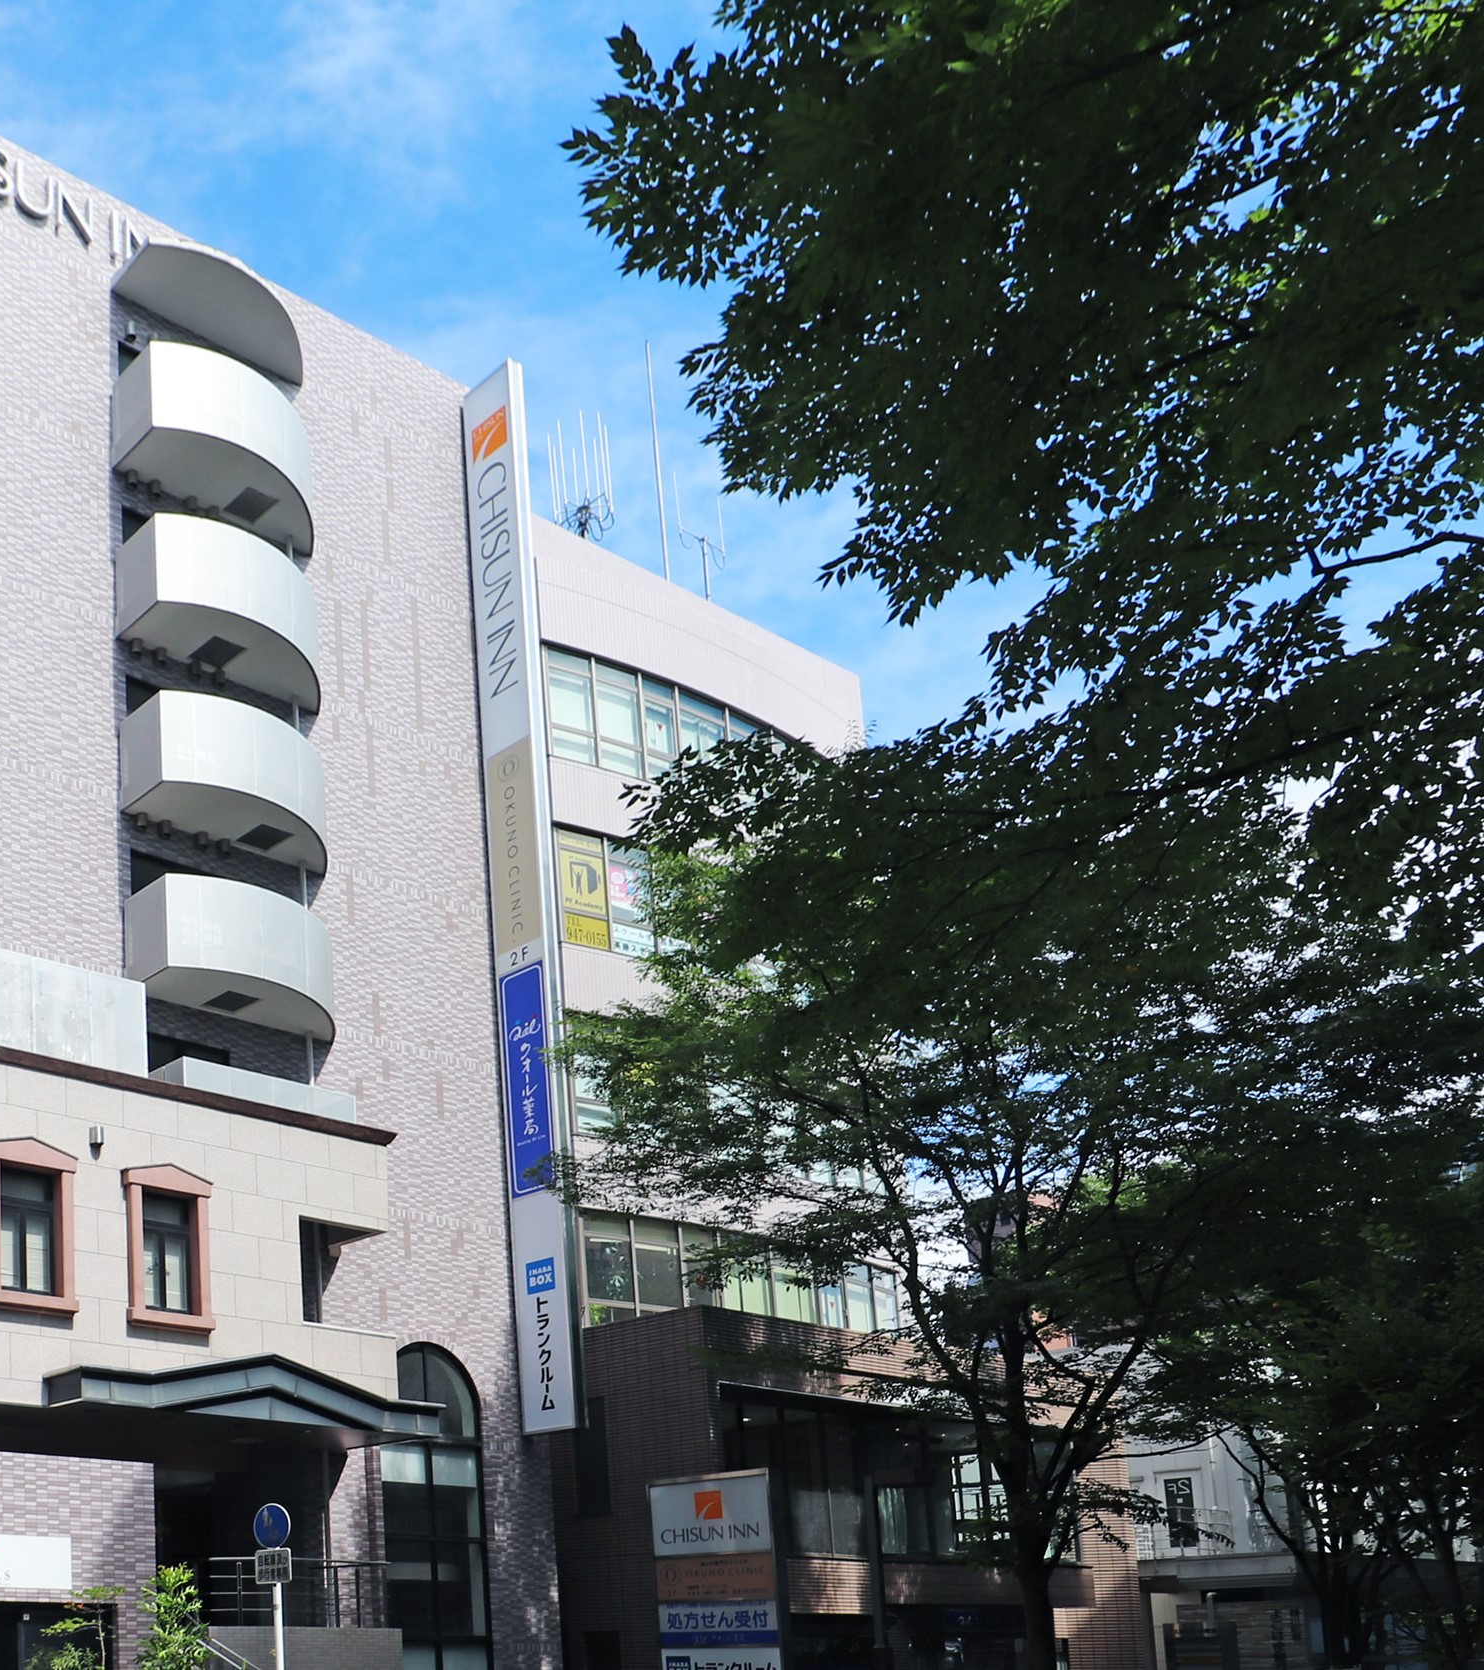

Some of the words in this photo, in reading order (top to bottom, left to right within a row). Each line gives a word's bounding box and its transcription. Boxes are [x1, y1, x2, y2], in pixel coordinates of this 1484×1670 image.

[109, 209, 147, 261] IN
[477, 461, 514, 620] CHISUN
[487, 619, 519, 699] INN
[503, 786, 519, 859] OKUNO
[566, 915, 582, 927] TEL
[566, 927, 608, 947] 947-0155
[509, 946, 529, 966] 2F
[519, 1042, 539, 1136] クオール薬局
[529, 1265, 552, 1276] INABA
[529, 1272, 553, 1287] BOX
[536, 1297, 556, 1411] トランクルーム
[660, 1525, 724, 1545] CHISUN
[728, 1522, 760, 1539] INN
[685, 1567, 725, 1578] OKUNO
[727, 1566, 767, 1576] CLINIC
[667, 1610, 768, 1630] 処方せん受付
